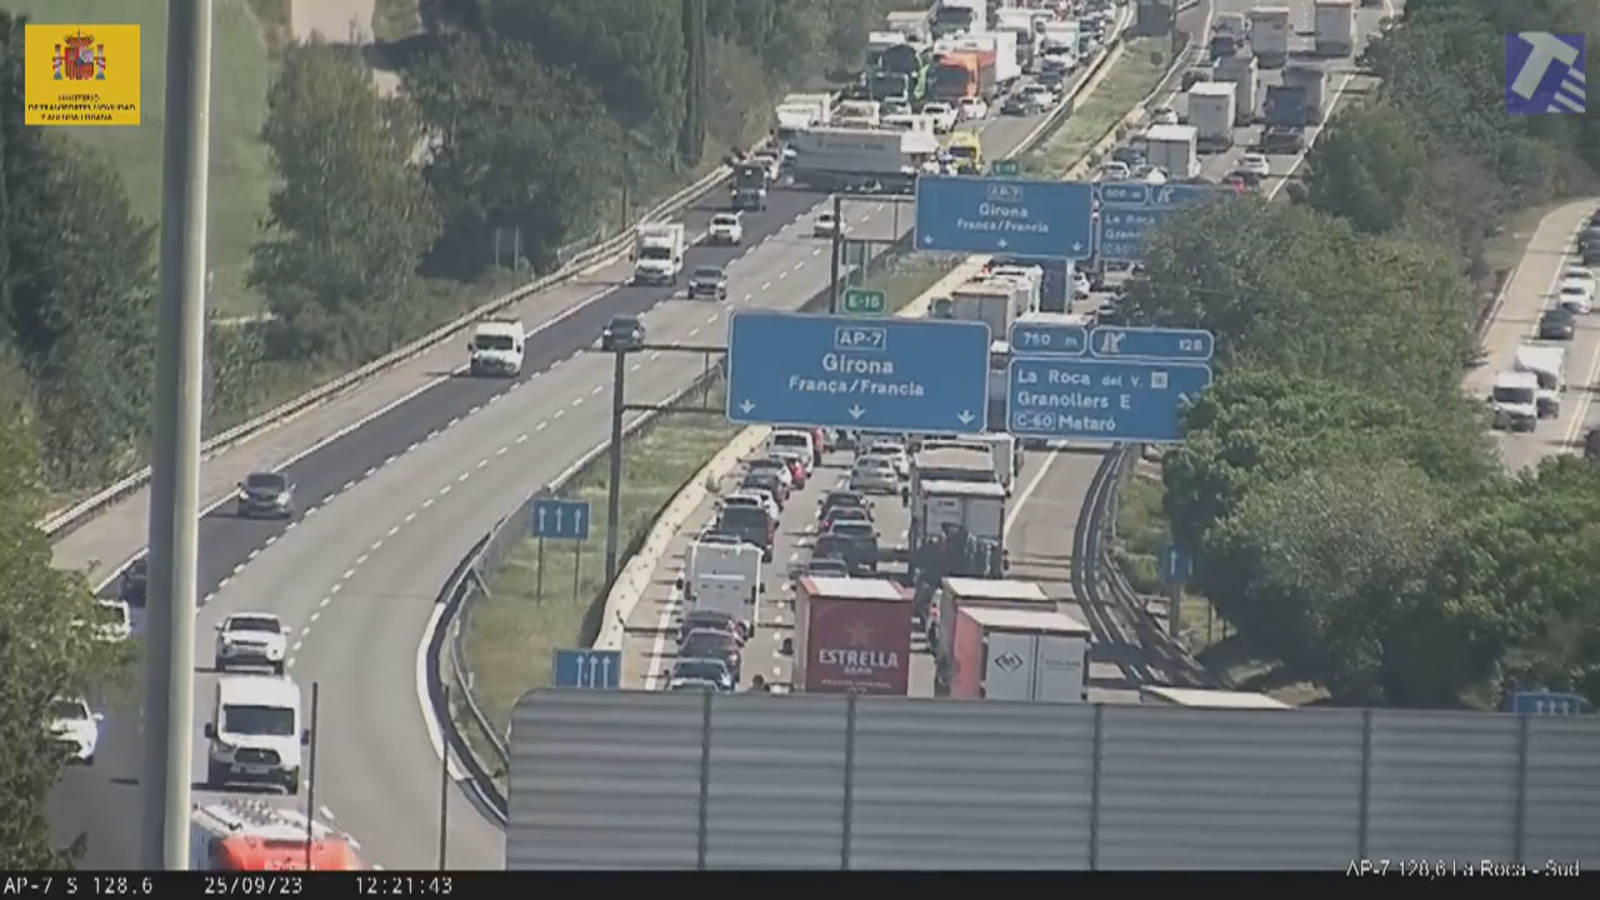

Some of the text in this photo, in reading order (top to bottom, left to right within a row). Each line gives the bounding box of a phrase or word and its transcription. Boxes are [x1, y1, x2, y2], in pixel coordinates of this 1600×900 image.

[979, 201, 1029, 218] Girona
[848, 295, 881, 308] E-15
[839, 331, 883, 346] AP-7
[1024, 332, 1078, 347] 750 m
[1178, 338, 1204, 351] 128
[822, 353, 895, 375] Girona
[788, 374, 925, 397] França/Francia
[1017, 369, 1038, 384] La
[1049, 370, 1091, 386] Roca
[1101, 374, 1122, 387] del
[1017, 391, 1132, 410] Granollers E
[1016, 414, 1117, 432] C-60 Mataró
[819, 648, 899, 670] ESTRELLA
